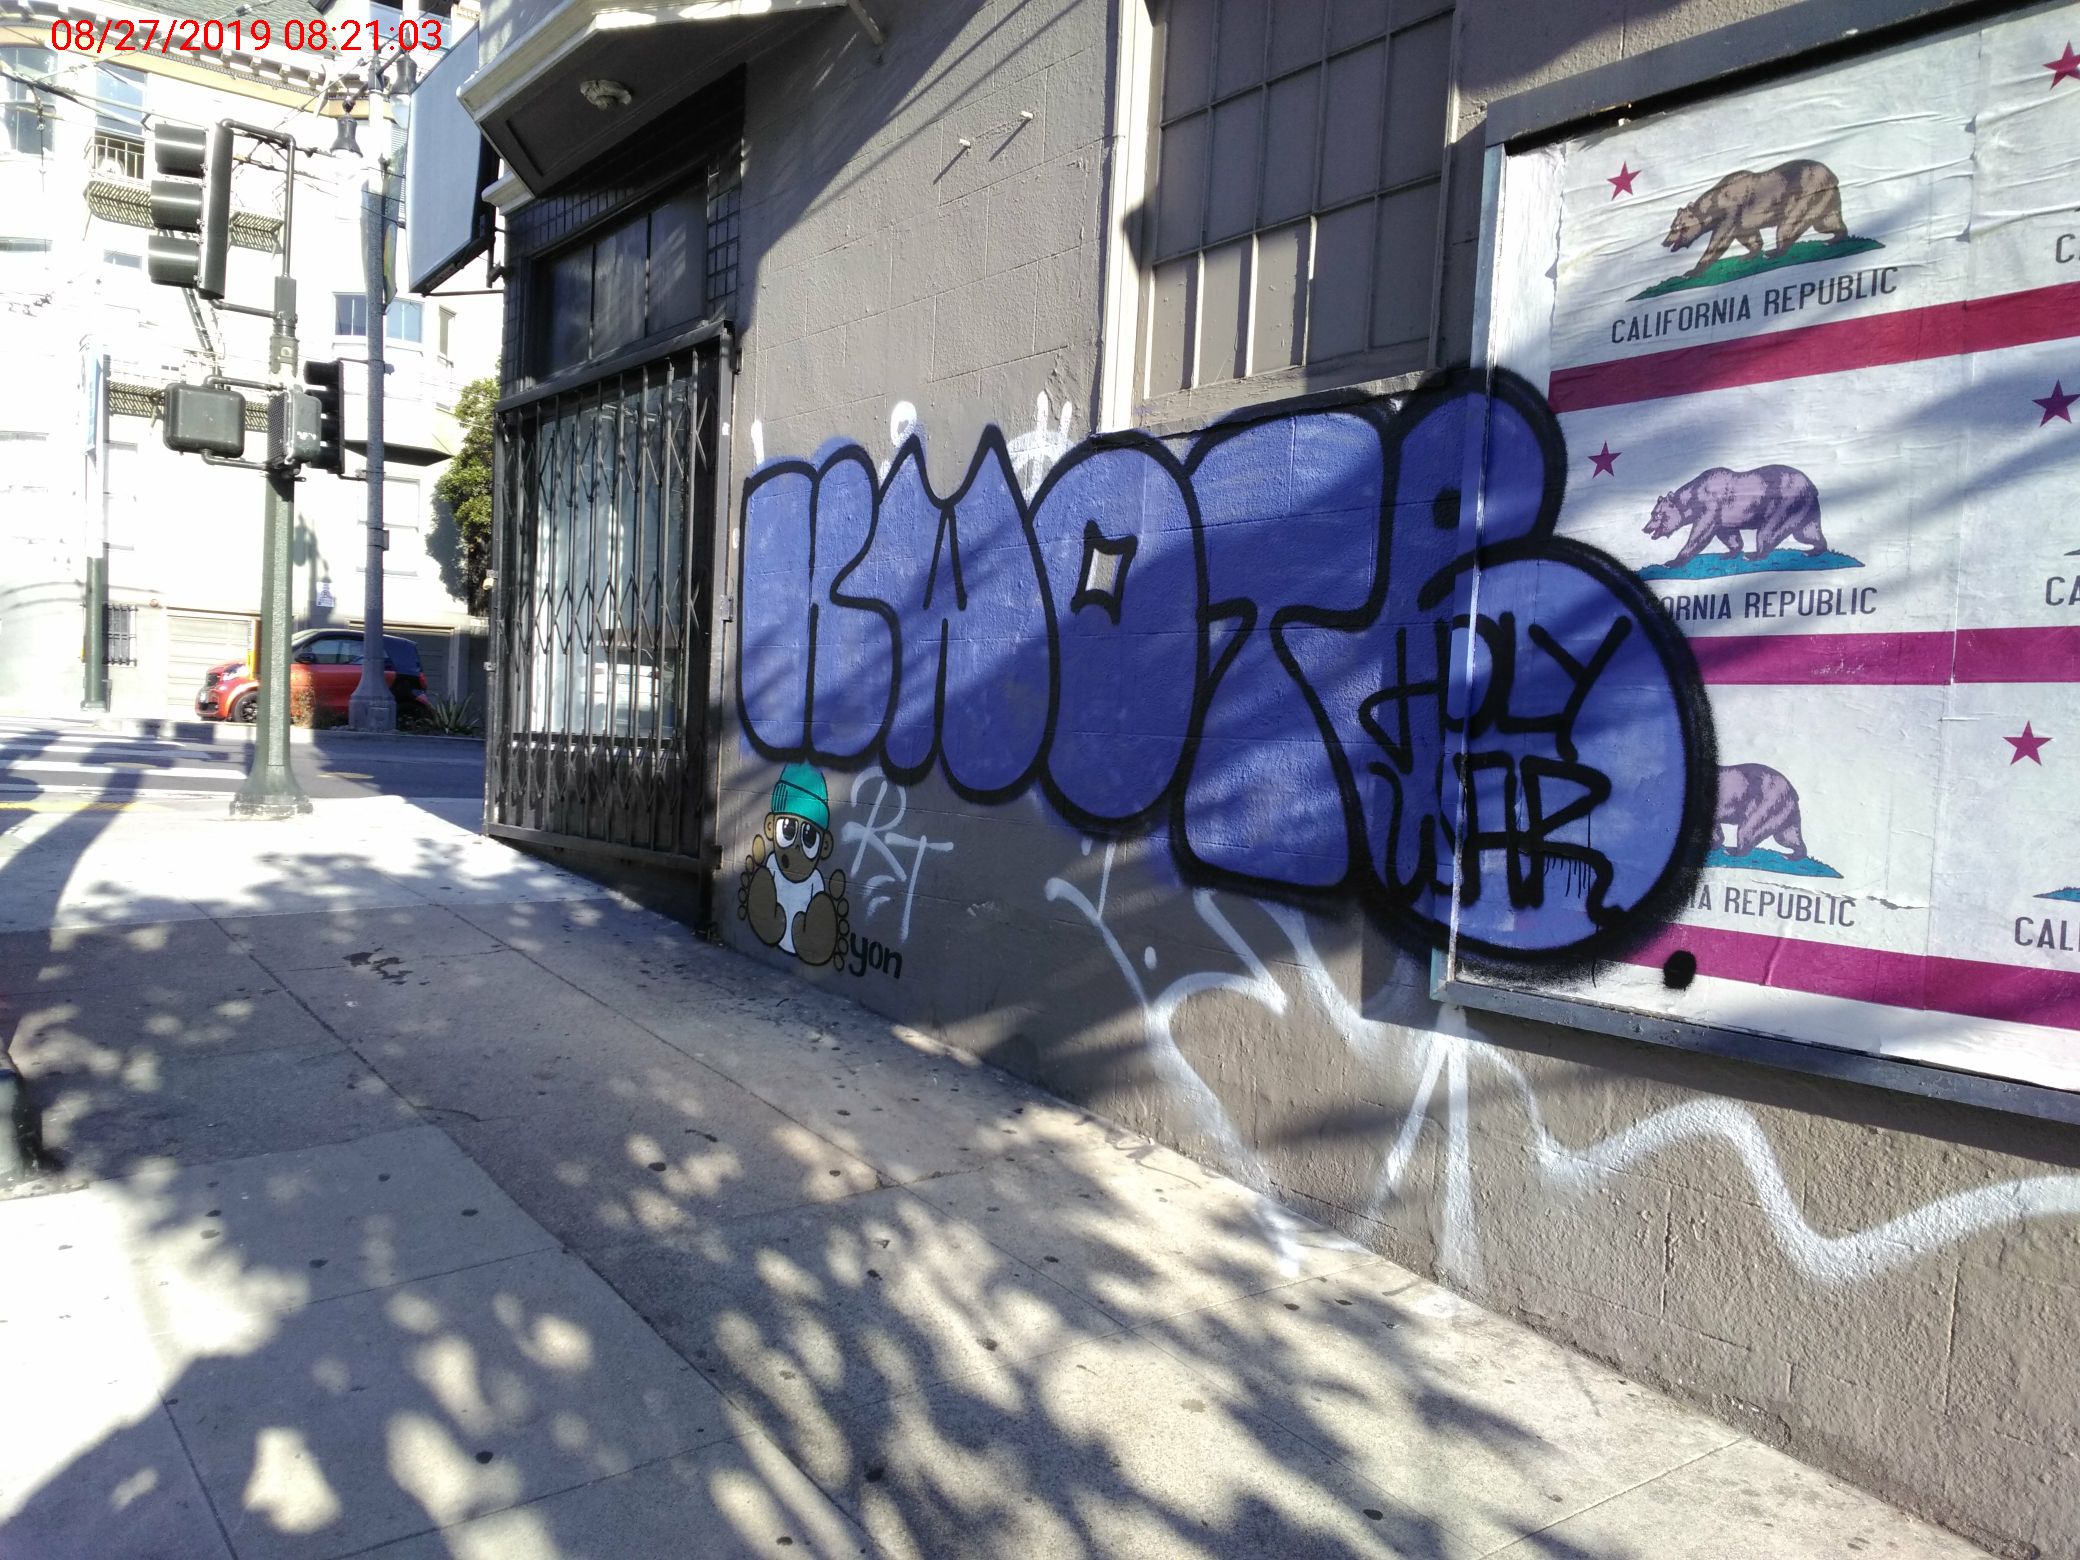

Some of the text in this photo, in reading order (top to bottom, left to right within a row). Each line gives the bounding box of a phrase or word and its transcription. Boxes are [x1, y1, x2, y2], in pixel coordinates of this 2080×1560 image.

[1611, 266, 1899, 344] CALIFORNIA REPUBLIC
[1744, 587, 1877, 618] REPUBLIC
[1724, 886, 1857, 927] REPUBLIC
[2014, 916, 2080, 952] CAL
[849, 932, 903, 980] yon
